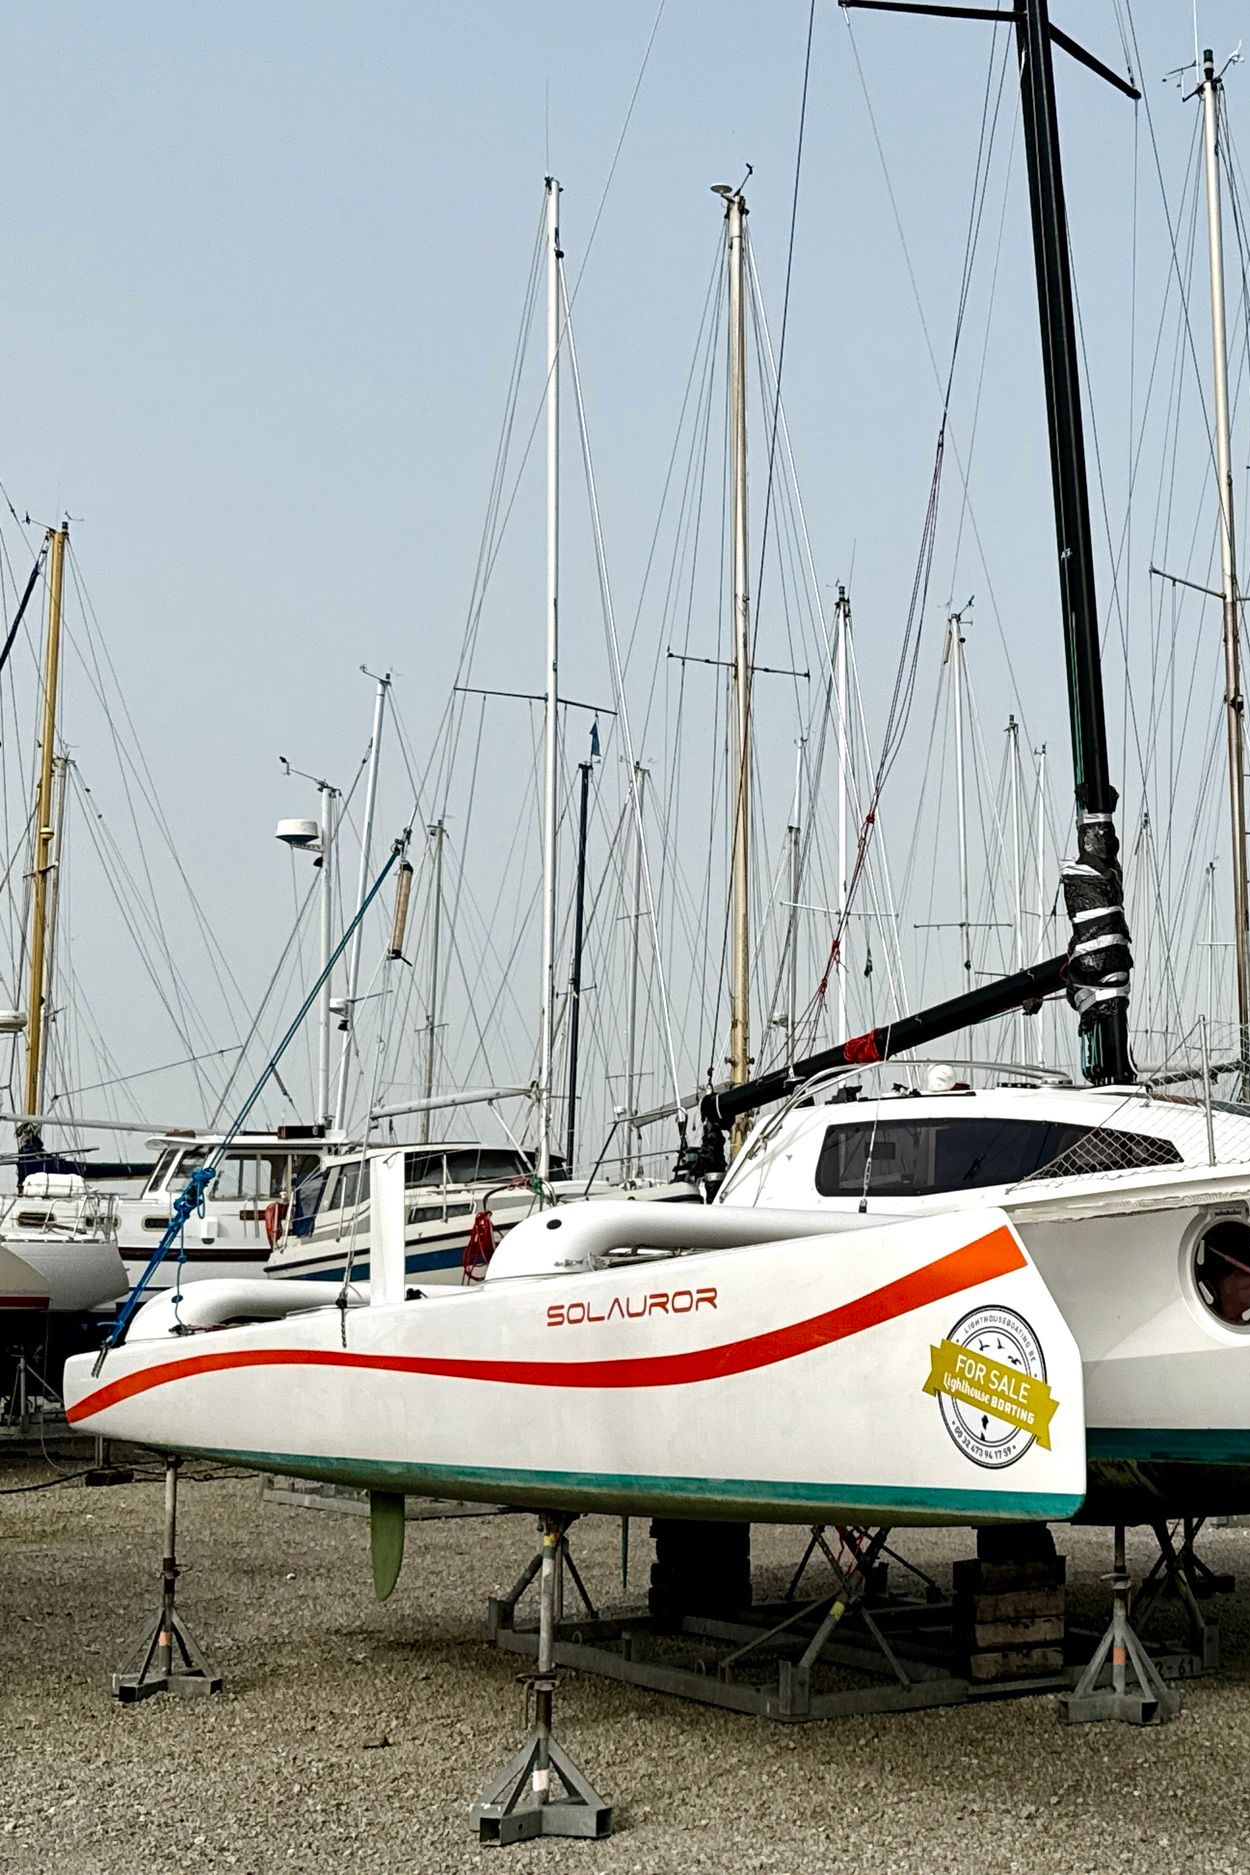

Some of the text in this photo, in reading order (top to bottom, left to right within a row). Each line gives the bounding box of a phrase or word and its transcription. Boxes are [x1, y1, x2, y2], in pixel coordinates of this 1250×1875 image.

[547, 1287, 718, 1327] SOLAUROR
[955, 1354, 1031, 1404] FOR SALE
[990, 1395, 1035, 1425] BOATING
[962, 1436, 971, 1448] 32
